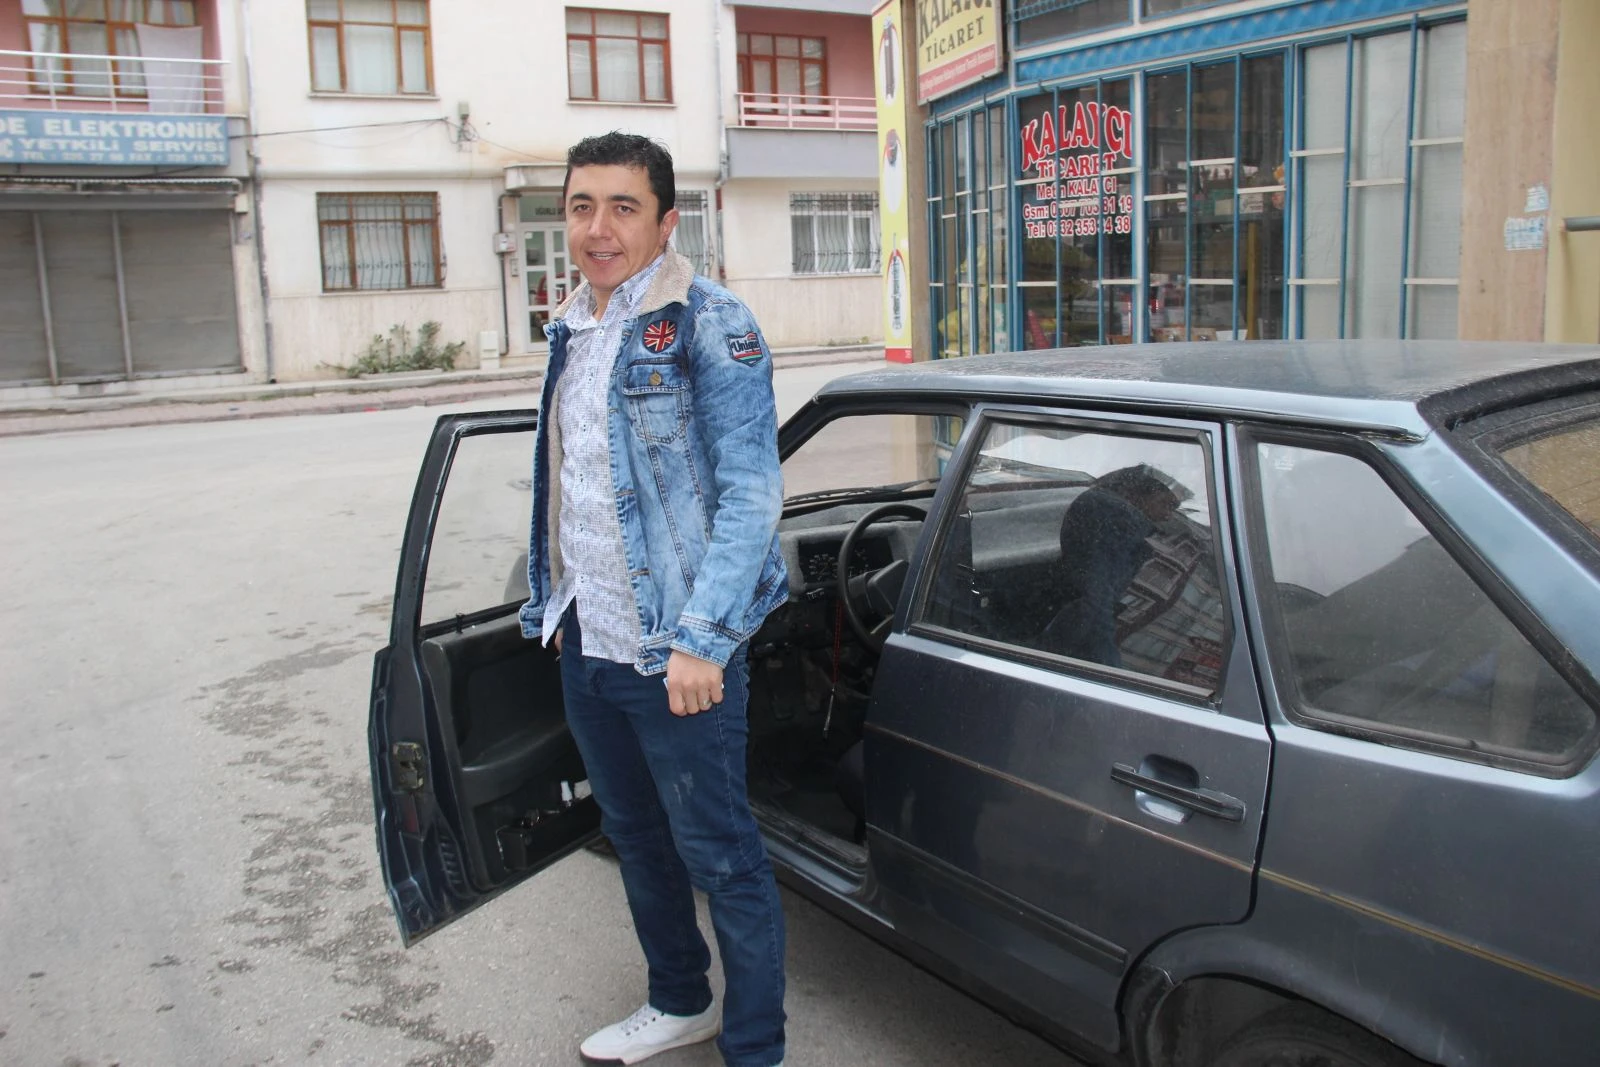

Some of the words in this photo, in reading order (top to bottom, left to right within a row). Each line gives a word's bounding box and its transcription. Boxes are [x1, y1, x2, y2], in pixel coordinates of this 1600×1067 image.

[1021, 101, 1132, 172] KALAYCI
[1036, 183, 1067, 200] Metn
[1067, 176, 1117, 198] KALACI
[1119, 195, 1133, 213] 19
[1075, 217, 1097, 236] 353
[1115, 215, 1131, 233] 38
